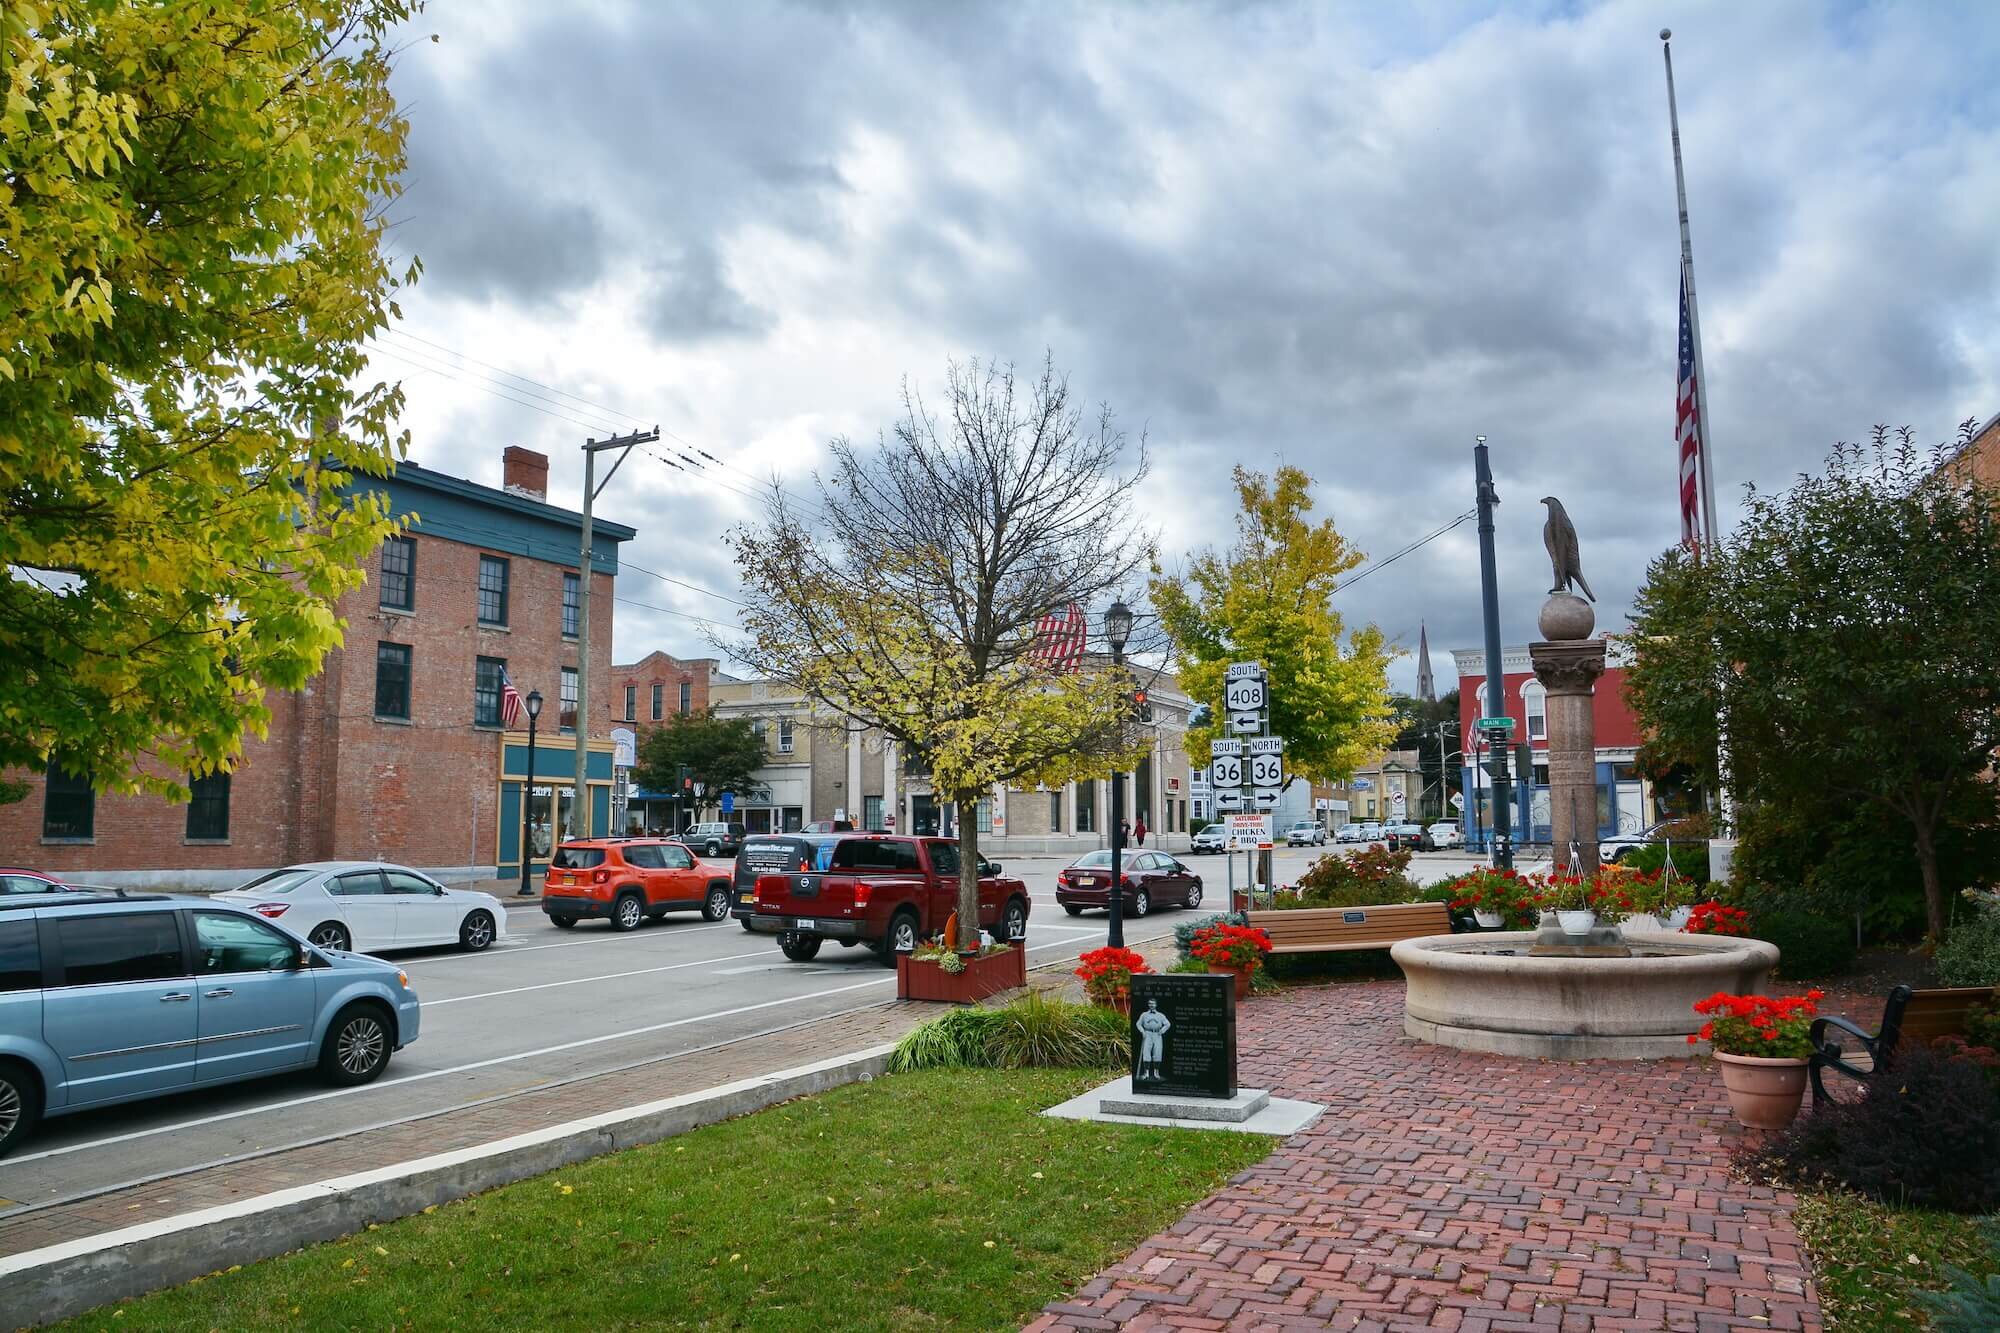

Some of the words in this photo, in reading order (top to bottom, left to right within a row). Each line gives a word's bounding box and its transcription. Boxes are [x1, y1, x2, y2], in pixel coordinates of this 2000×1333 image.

[1231, 665, 1258, 676] SOUTH
[1230, 689, 1261, 705] 408
[1213, 741, 1241, 752] SOUTH
[1252, 739, 1280, 750] NORTH
[1215, 763, 1240, 781] 36
[1255, 761, 1280, 780] 36
[1232, 828, 1266, 836] CHICKEN
